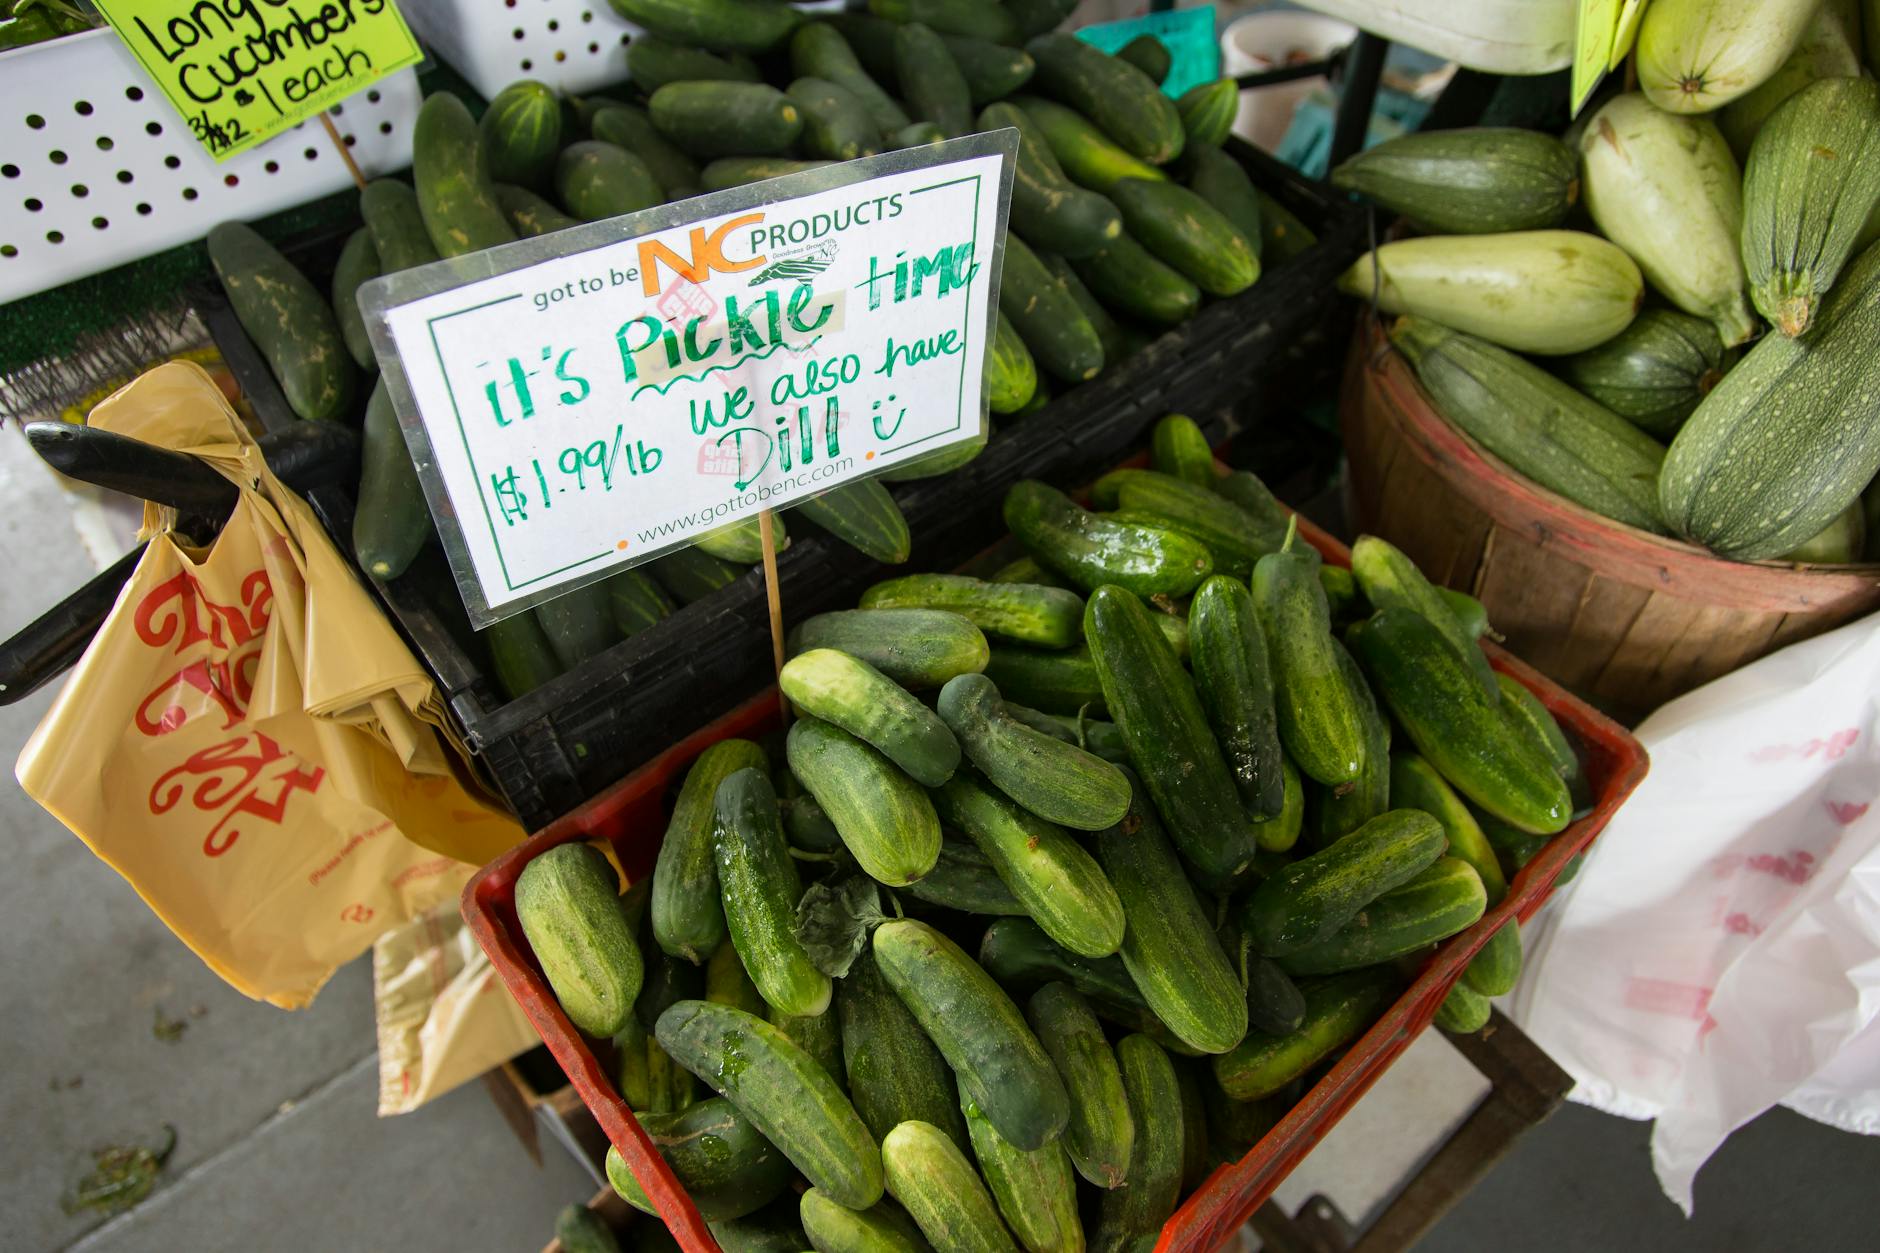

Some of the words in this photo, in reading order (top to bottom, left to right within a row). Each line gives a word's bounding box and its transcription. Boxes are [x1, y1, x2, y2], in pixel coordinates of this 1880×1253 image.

[282, 44, 371, 102] each
[534, 282, 575, 311] got
[580, 276, 604, 295] to
[610, 267, 638, 287] be
[637, 212, 768, 297] NC
[750, 193, 904, 254] PRODUCTS
[476, 345, 590, 427] it's
[771, 354, 860, 405] also
[874, 329, 964, 378] have
[491, 424, 662, 526] $1.99/lb
[716, 395, 840, 491] Dill
[637, 457, 854, 543] www.gottobenc.com
[134, 570, 273, 655] Tha
[135, 648, 262, 736] Yo
